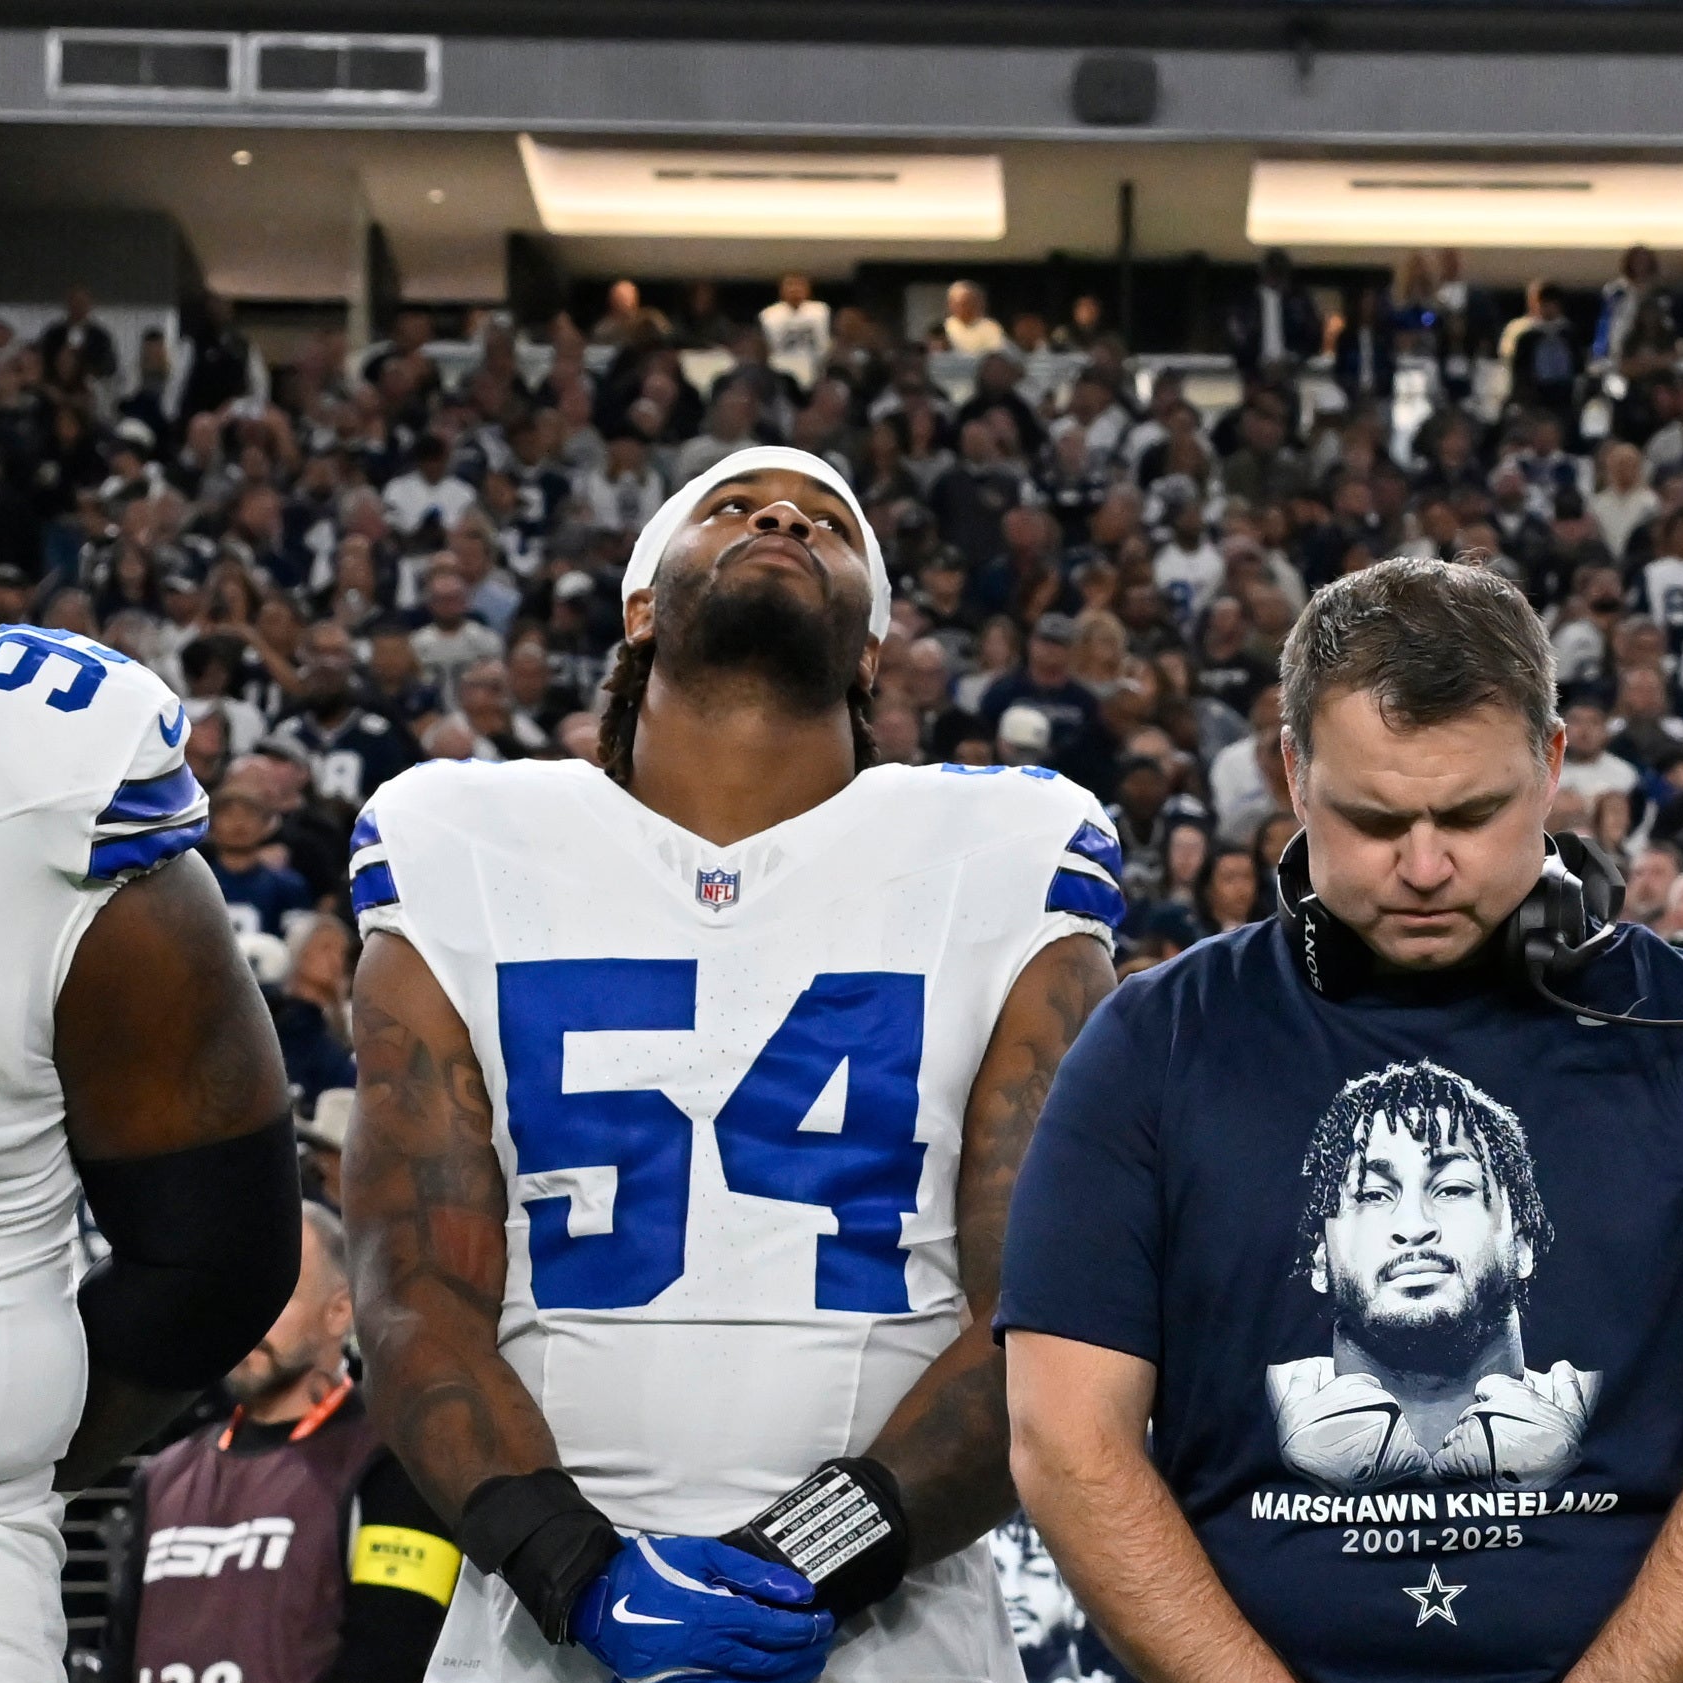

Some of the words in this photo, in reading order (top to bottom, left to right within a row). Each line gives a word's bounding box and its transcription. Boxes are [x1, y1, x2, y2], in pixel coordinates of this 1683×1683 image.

[702, 883, 733, 901] NFL
[497, 958, 927, 1314] 54
[1251, 1491, 1437, 1524] MARSHAWN
[1446, 1490, 1619, 1519] KNEELAND
[143, 1516, 295, 1584] ESPN
[1341, 1524, 1525, 1554] 2001-2025
